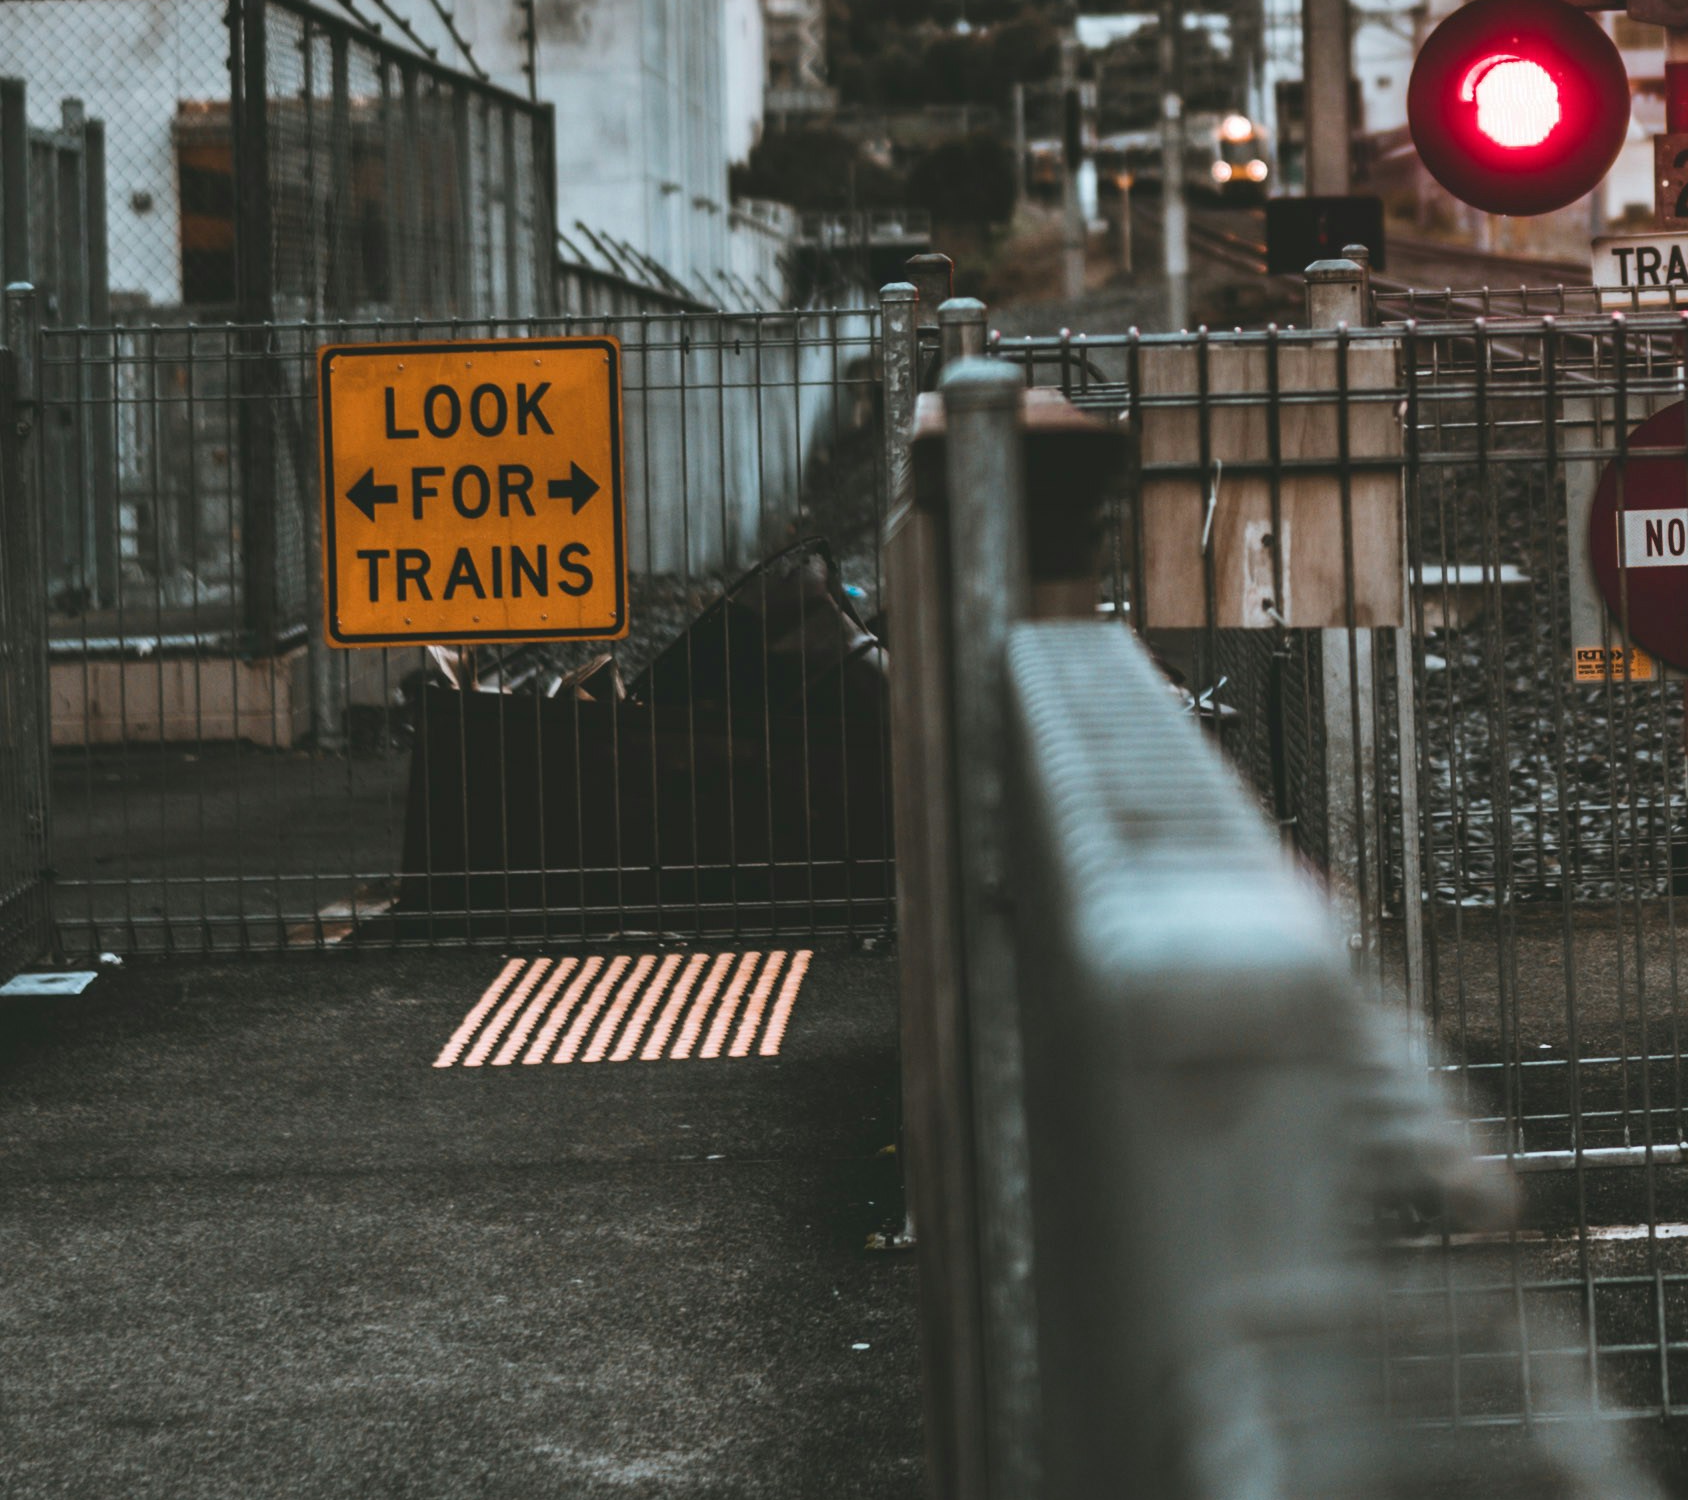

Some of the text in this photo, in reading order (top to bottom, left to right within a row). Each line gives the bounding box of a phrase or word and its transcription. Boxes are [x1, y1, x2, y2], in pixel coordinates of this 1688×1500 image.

[384, 382, 554, 439] LOOK
[411, 464, 536, 520] FOR
[1645, 518, 1686, 557] NO
[356, 542, 594, 602] TRAINS
